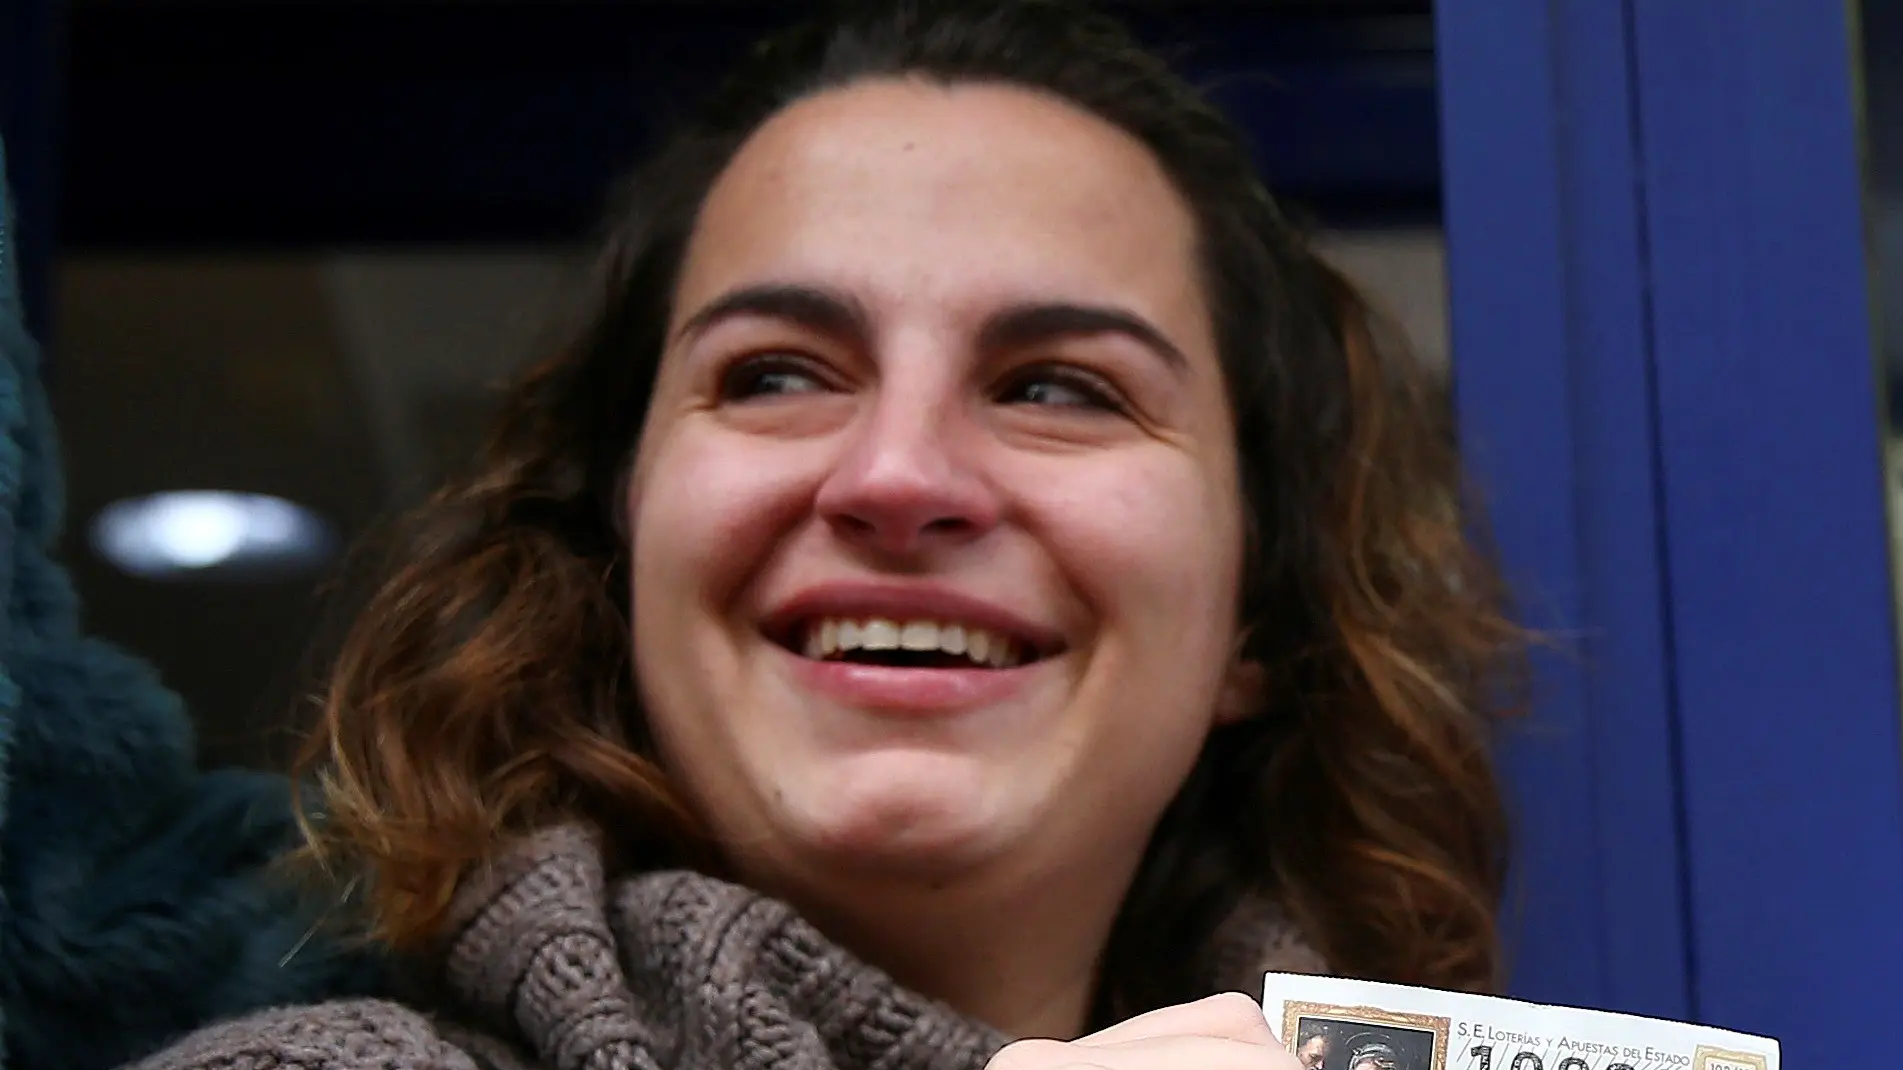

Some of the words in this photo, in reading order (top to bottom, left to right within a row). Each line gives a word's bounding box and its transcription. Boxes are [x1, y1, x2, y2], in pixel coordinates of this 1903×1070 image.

[1557, 1036, 1620, 1057] APUESTAS
[1622, 1047, 1642, 1060] DEL
[1644, 1046, 1691, 1067] ESTADO
